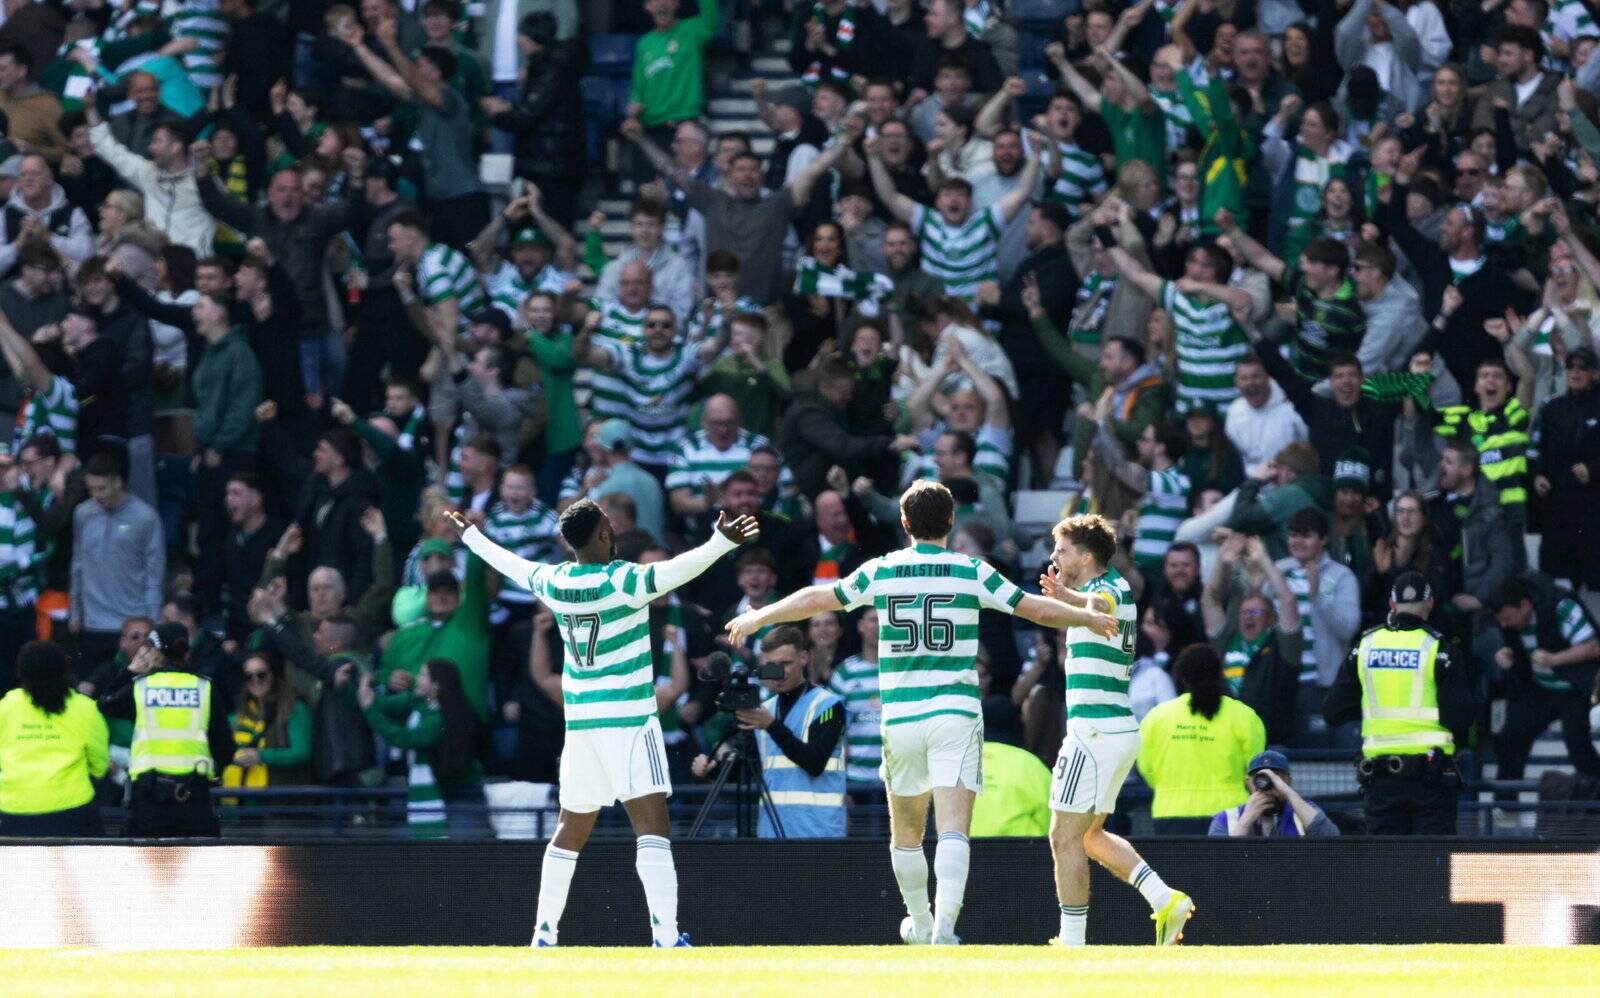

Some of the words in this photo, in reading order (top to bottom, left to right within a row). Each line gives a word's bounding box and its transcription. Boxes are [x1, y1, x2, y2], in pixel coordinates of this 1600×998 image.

[895, 563, 952, 578] RALSTON
[887, 593, 957, 652] 56
[562, 612, 601, 667] 17
[1369, 650, 1419, 667] POLICE
[146, 688, 198, 706] POLICE
